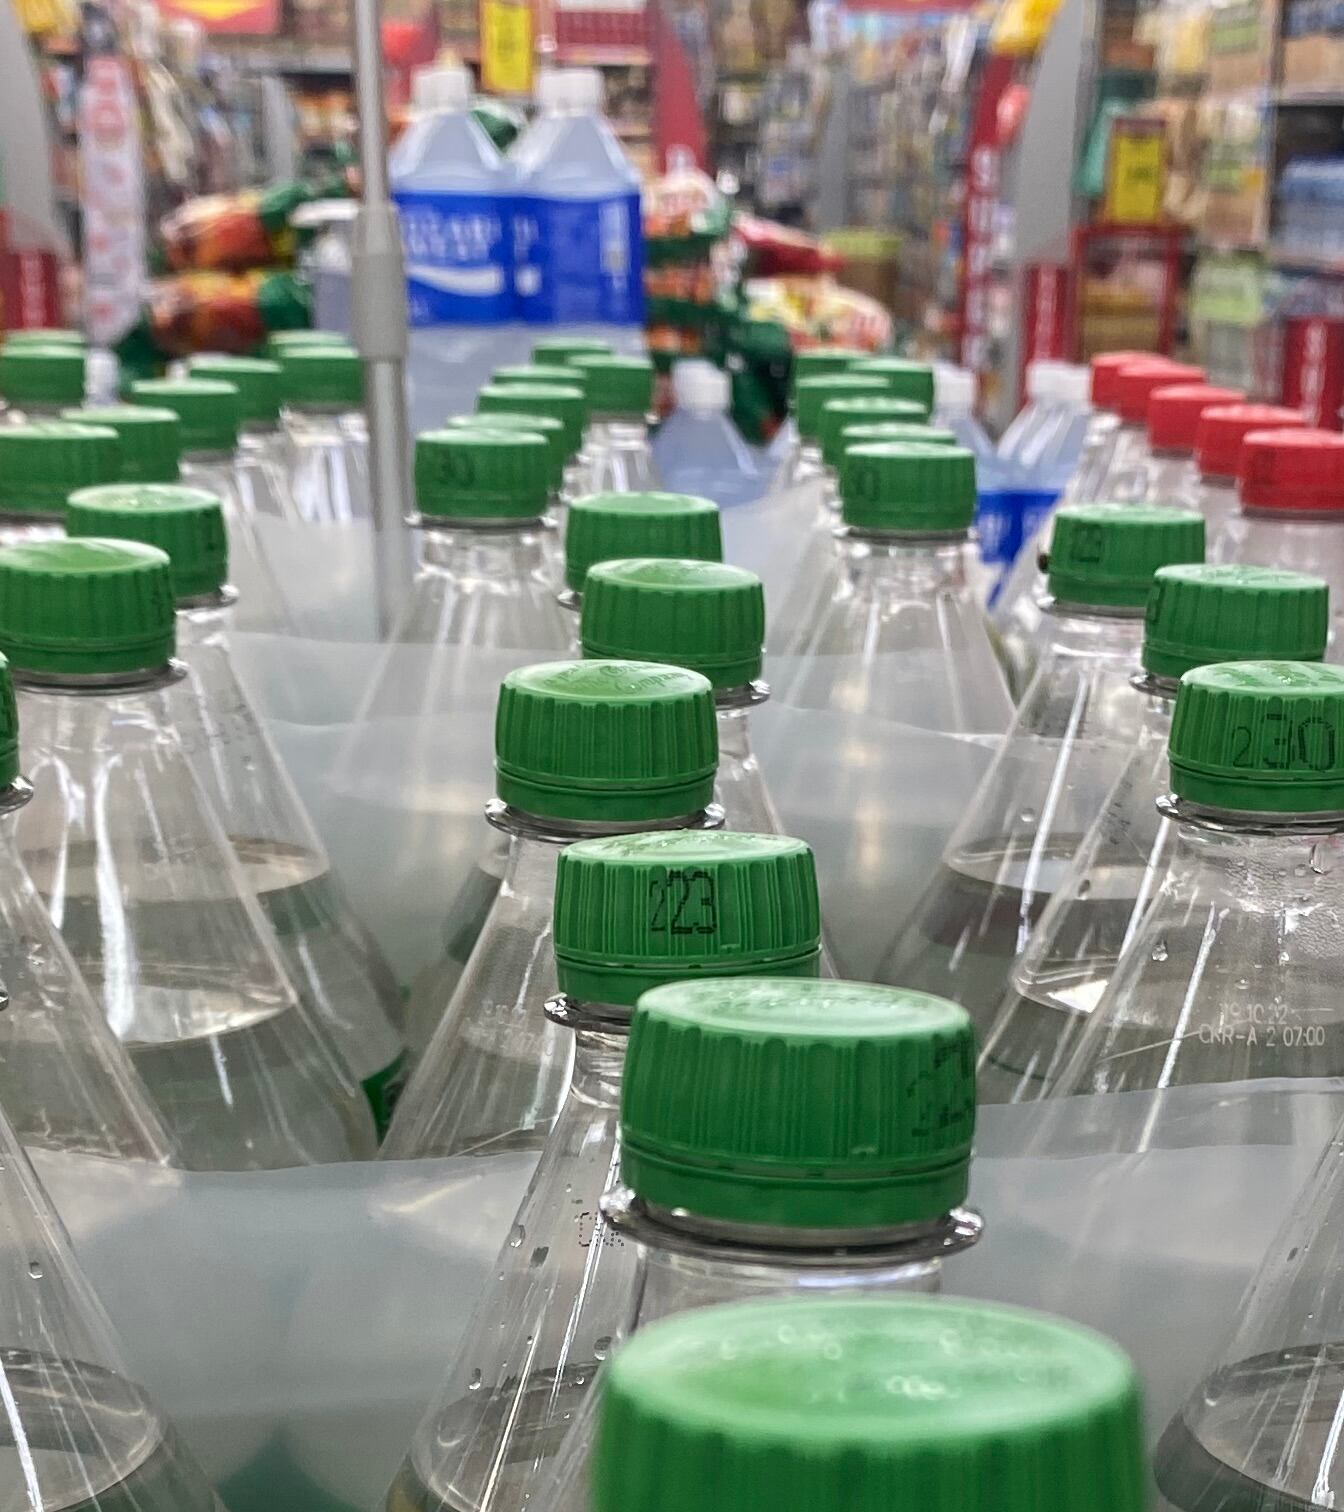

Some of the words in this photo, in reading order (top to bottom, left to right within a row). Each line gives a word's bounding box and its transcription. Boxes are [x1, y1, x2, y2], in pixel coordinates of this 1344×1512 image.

[1232, 713, 1336, 773] 230
[649, 868, 718, 935] 223
[1266, 1027, 1276, 1047] 2
[1283, 1025, 1326, 1047] 07:00
